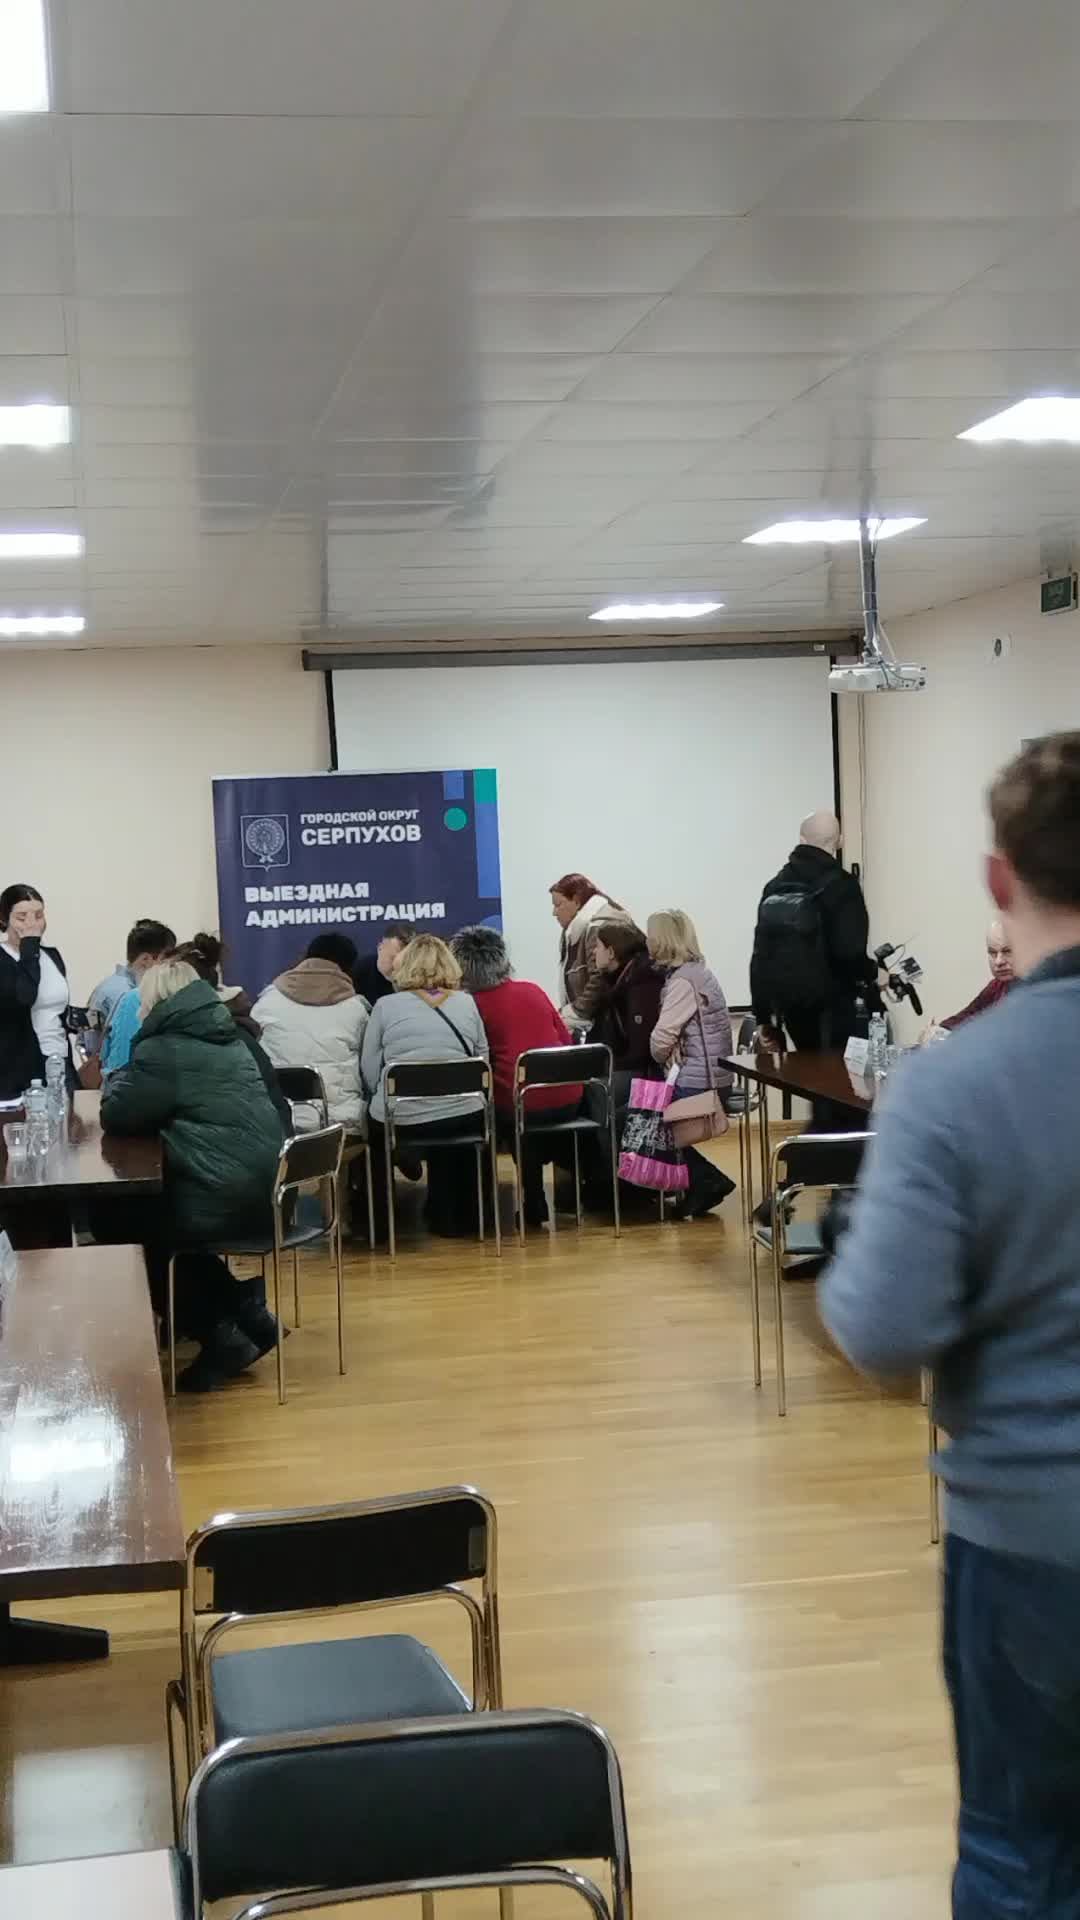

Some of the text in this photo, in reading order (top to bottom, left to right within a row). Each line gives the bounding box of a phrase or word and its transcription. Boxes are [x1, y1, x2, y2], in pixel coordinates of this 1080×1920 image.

[300, 808, 420, 825] ГОРОДСКОЙ ОКРУГ
[301, 824, 422, 846] СЕРПУХОВ
[244, 882, 370, 903] ВЫЕЗДНАЯ
[245, 902, 446, 928] АДМИНИСТРАЦИЯ
